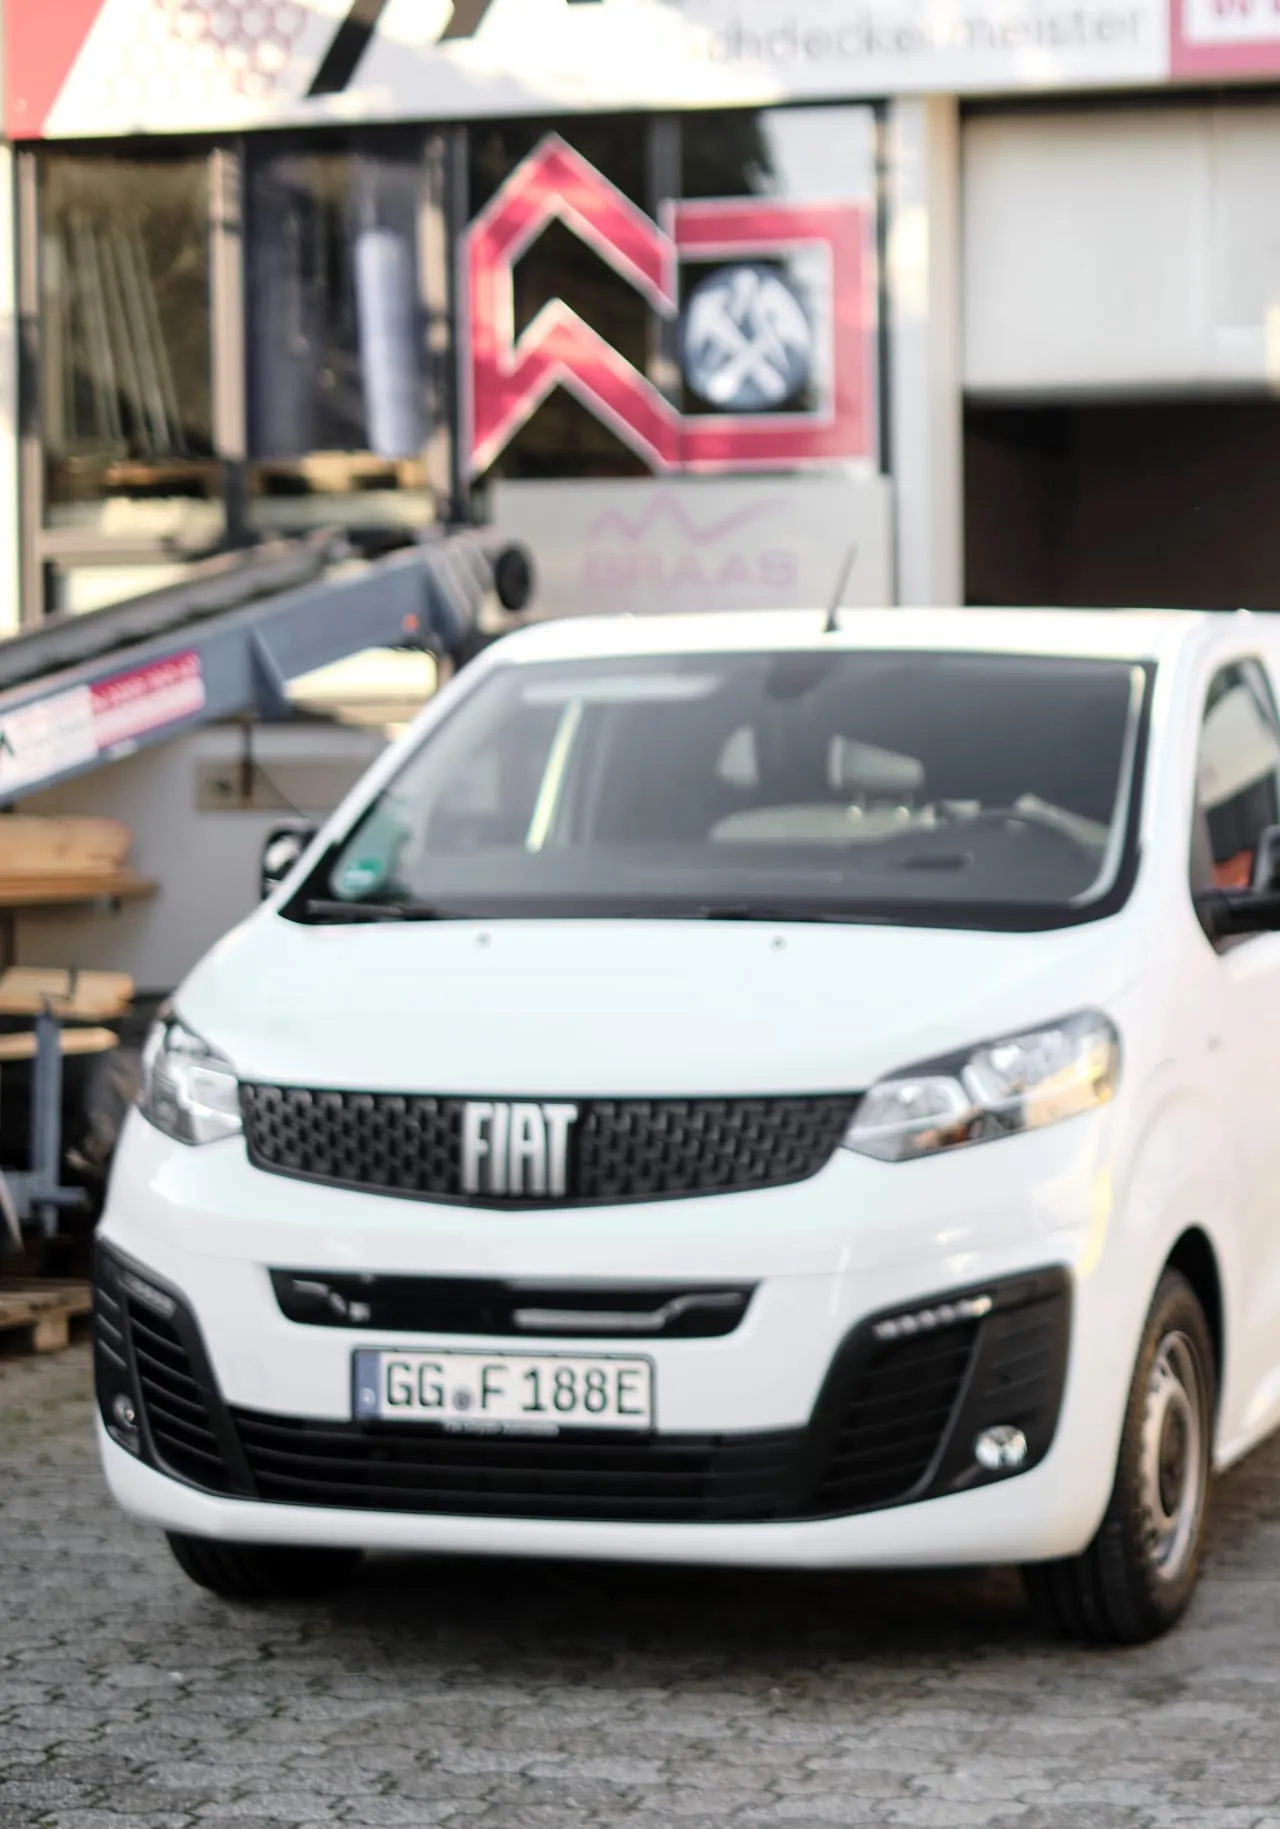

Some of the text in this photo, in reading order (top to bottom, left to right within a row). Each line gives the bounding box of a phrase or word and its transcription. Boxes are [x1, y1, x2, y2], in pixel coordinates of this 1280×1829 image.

[463, 1101, 578, 1197] FIAT
[387, 1362, 444, 1407] GG
[481, 1365, 507, 1410] F
[523, 1367, 644, 1415] 188E
